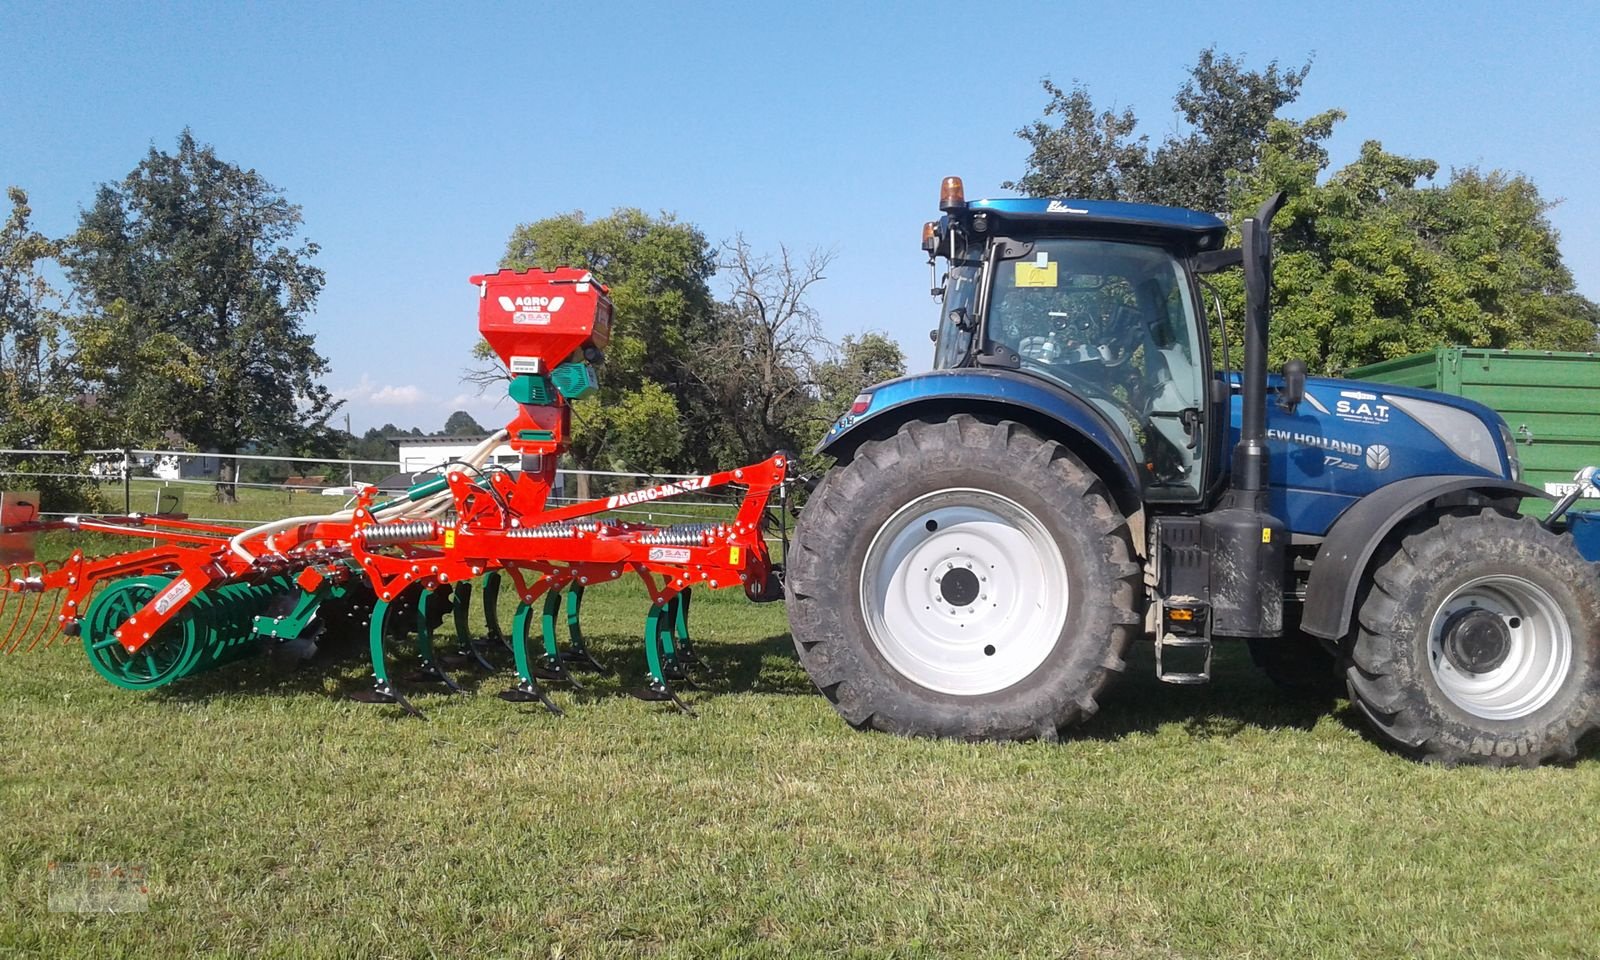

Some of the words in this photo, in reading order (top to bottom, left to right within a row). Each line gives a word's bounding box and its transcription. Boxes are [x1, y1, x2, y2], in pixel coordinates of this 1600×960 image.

[515, 296, 549, 306] AGRO
[1336, 400, 1389, 418] S.A.T.
[1265, 428, 1291, 440] EW
[1294, 432, 1362, 456] HOLLAND
[619, 478, 700, 506] AGRO-MASZ
